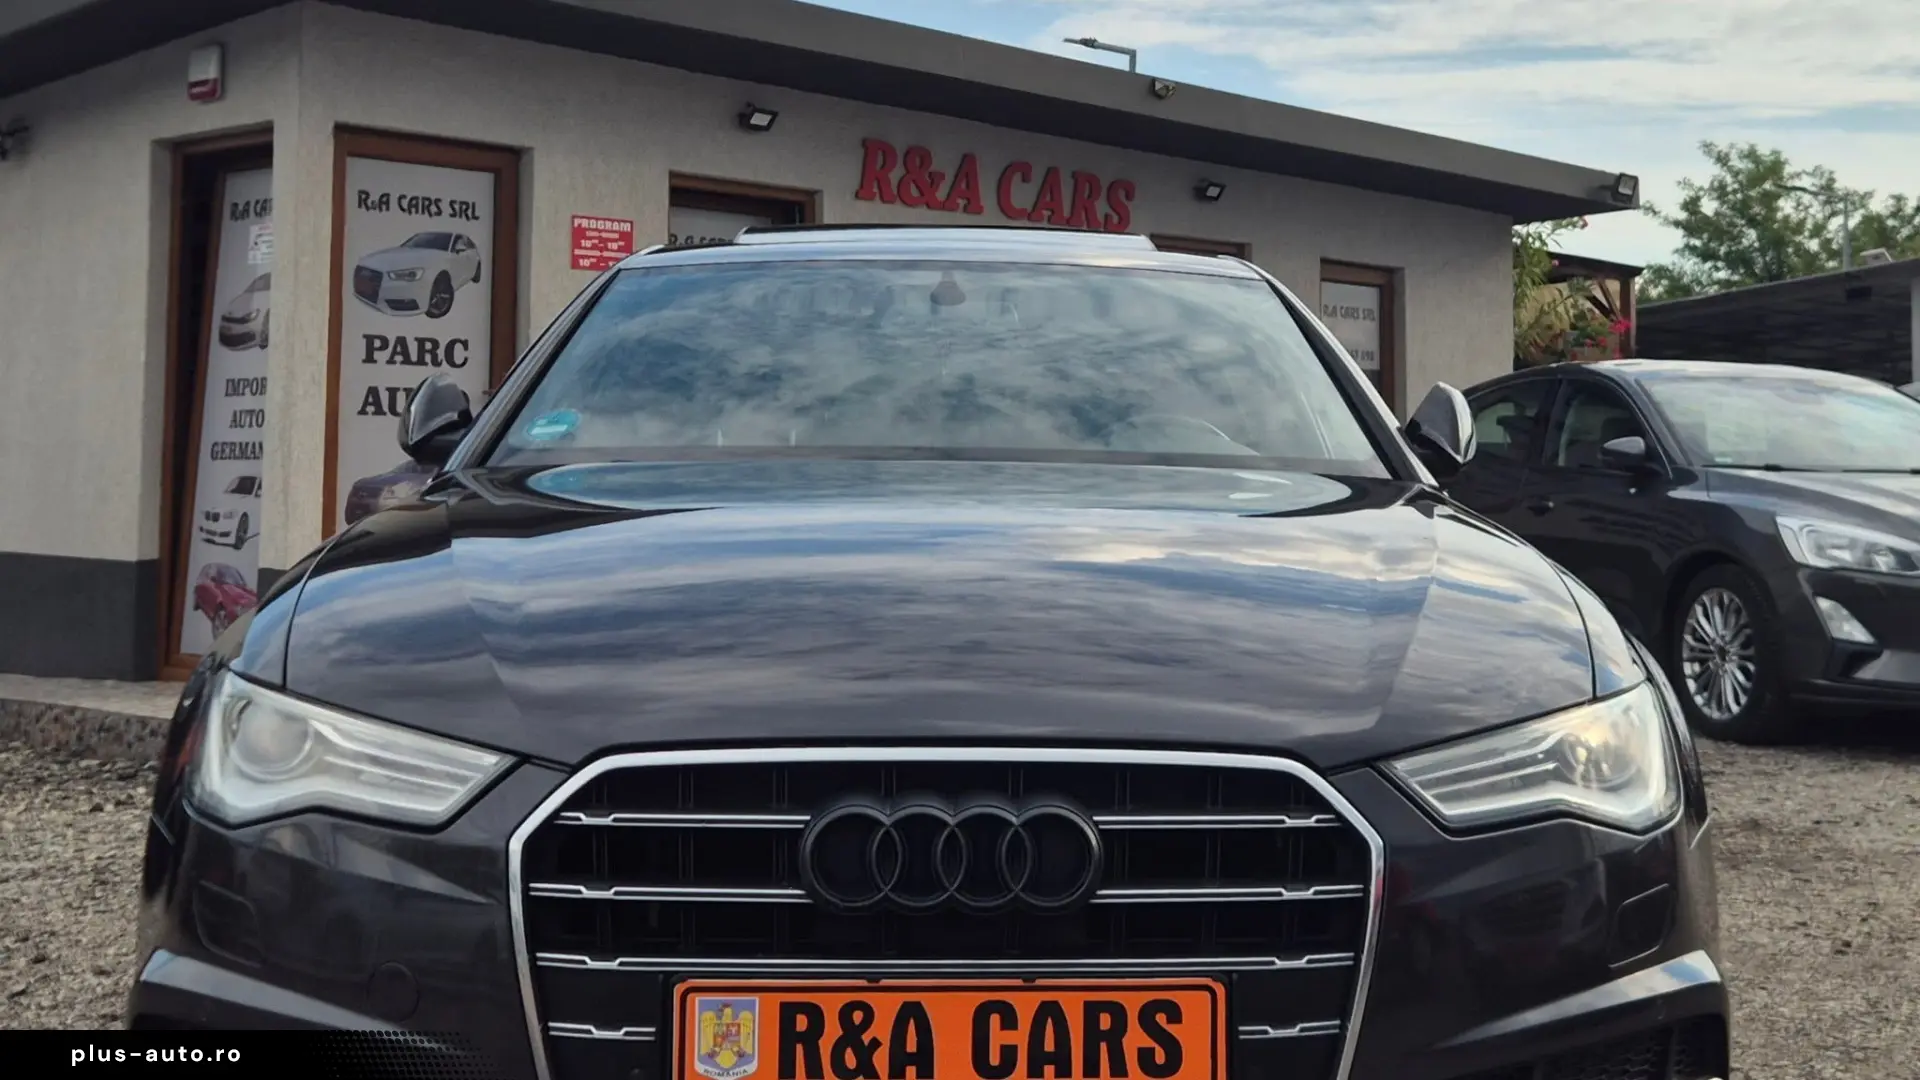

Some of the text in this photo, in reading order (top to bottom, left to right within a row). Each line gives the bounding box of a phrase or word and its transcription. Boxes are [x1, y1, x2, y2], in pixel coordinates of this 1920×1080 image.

[855, 138, 1136, 232] R&A CARS
[397, 194, 443, 218] CARS
[448, 200, 480, 221] SRL
[574, 218, 631, 232] PROGRAM
[361, 334, 469, 369] PARC
[228, 408, 265, 429] AUTO
[778, 998, 1183, 1080] R&A CARS
